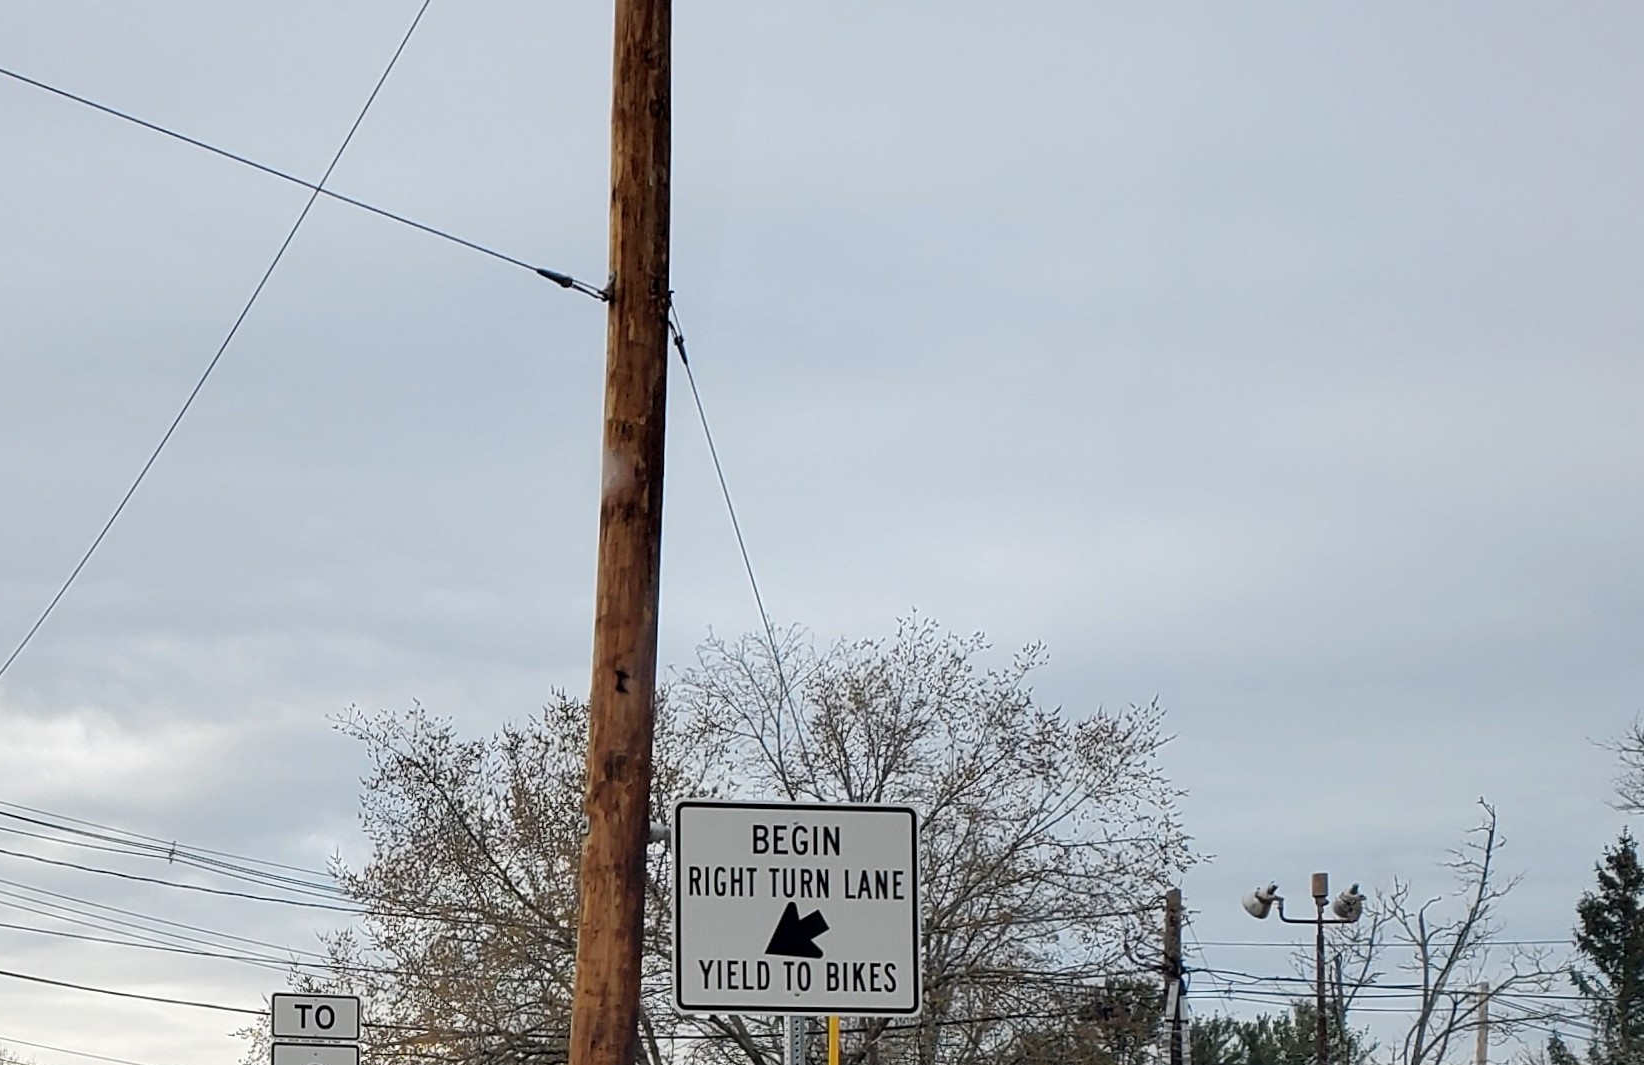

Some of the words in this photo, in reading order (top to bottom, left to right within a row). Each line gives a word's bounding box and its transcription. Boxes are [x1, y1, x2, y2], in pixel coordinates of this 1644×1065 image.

[752, 824, 841, 856] BEGIN
[689, 866, 757, 897] RIGHT
[769, 868, 830, 898] TURN
[844, 869, 904, 900] LANE
[698, 959, 771, 990] YIELD
[783, 960, 811, 992] TO
[826, 962, 897, 993] BIKES
[294, 1004, 336, 1030] TO
